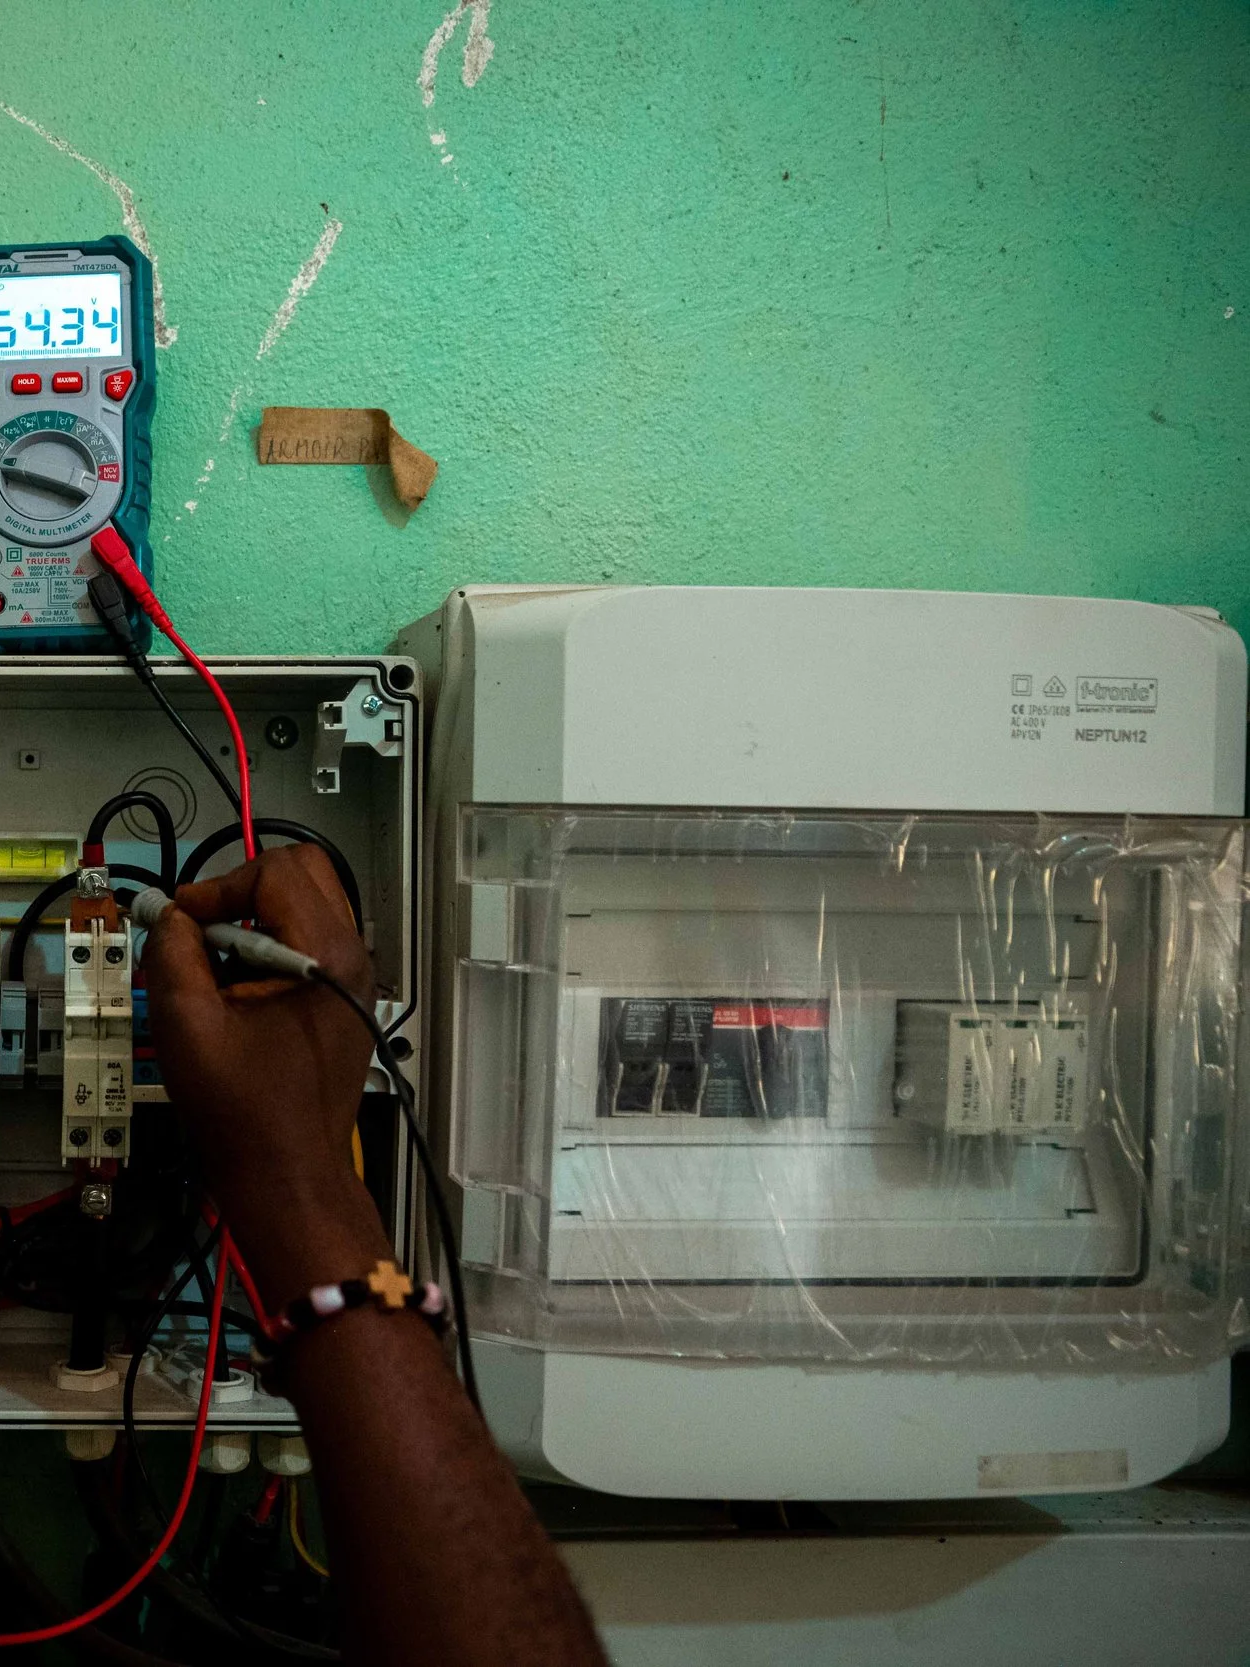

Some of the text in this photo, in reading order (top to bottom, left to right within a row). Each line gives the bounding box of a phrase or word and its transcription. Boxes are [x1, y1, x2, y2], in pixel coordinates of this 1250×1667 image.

[72, 263, 117, 271] TMT47504
[91, 297, 97, 305] V
[56, 376, 79, 384] MAX/MIN
[5, 512, 93, 536] DIGITAL MULTIMETER
[9, 603, 24, 611] mA
[1011, 717, 1021, 727] AC
[1075, 728, 1148, 743] NEPTUN12
